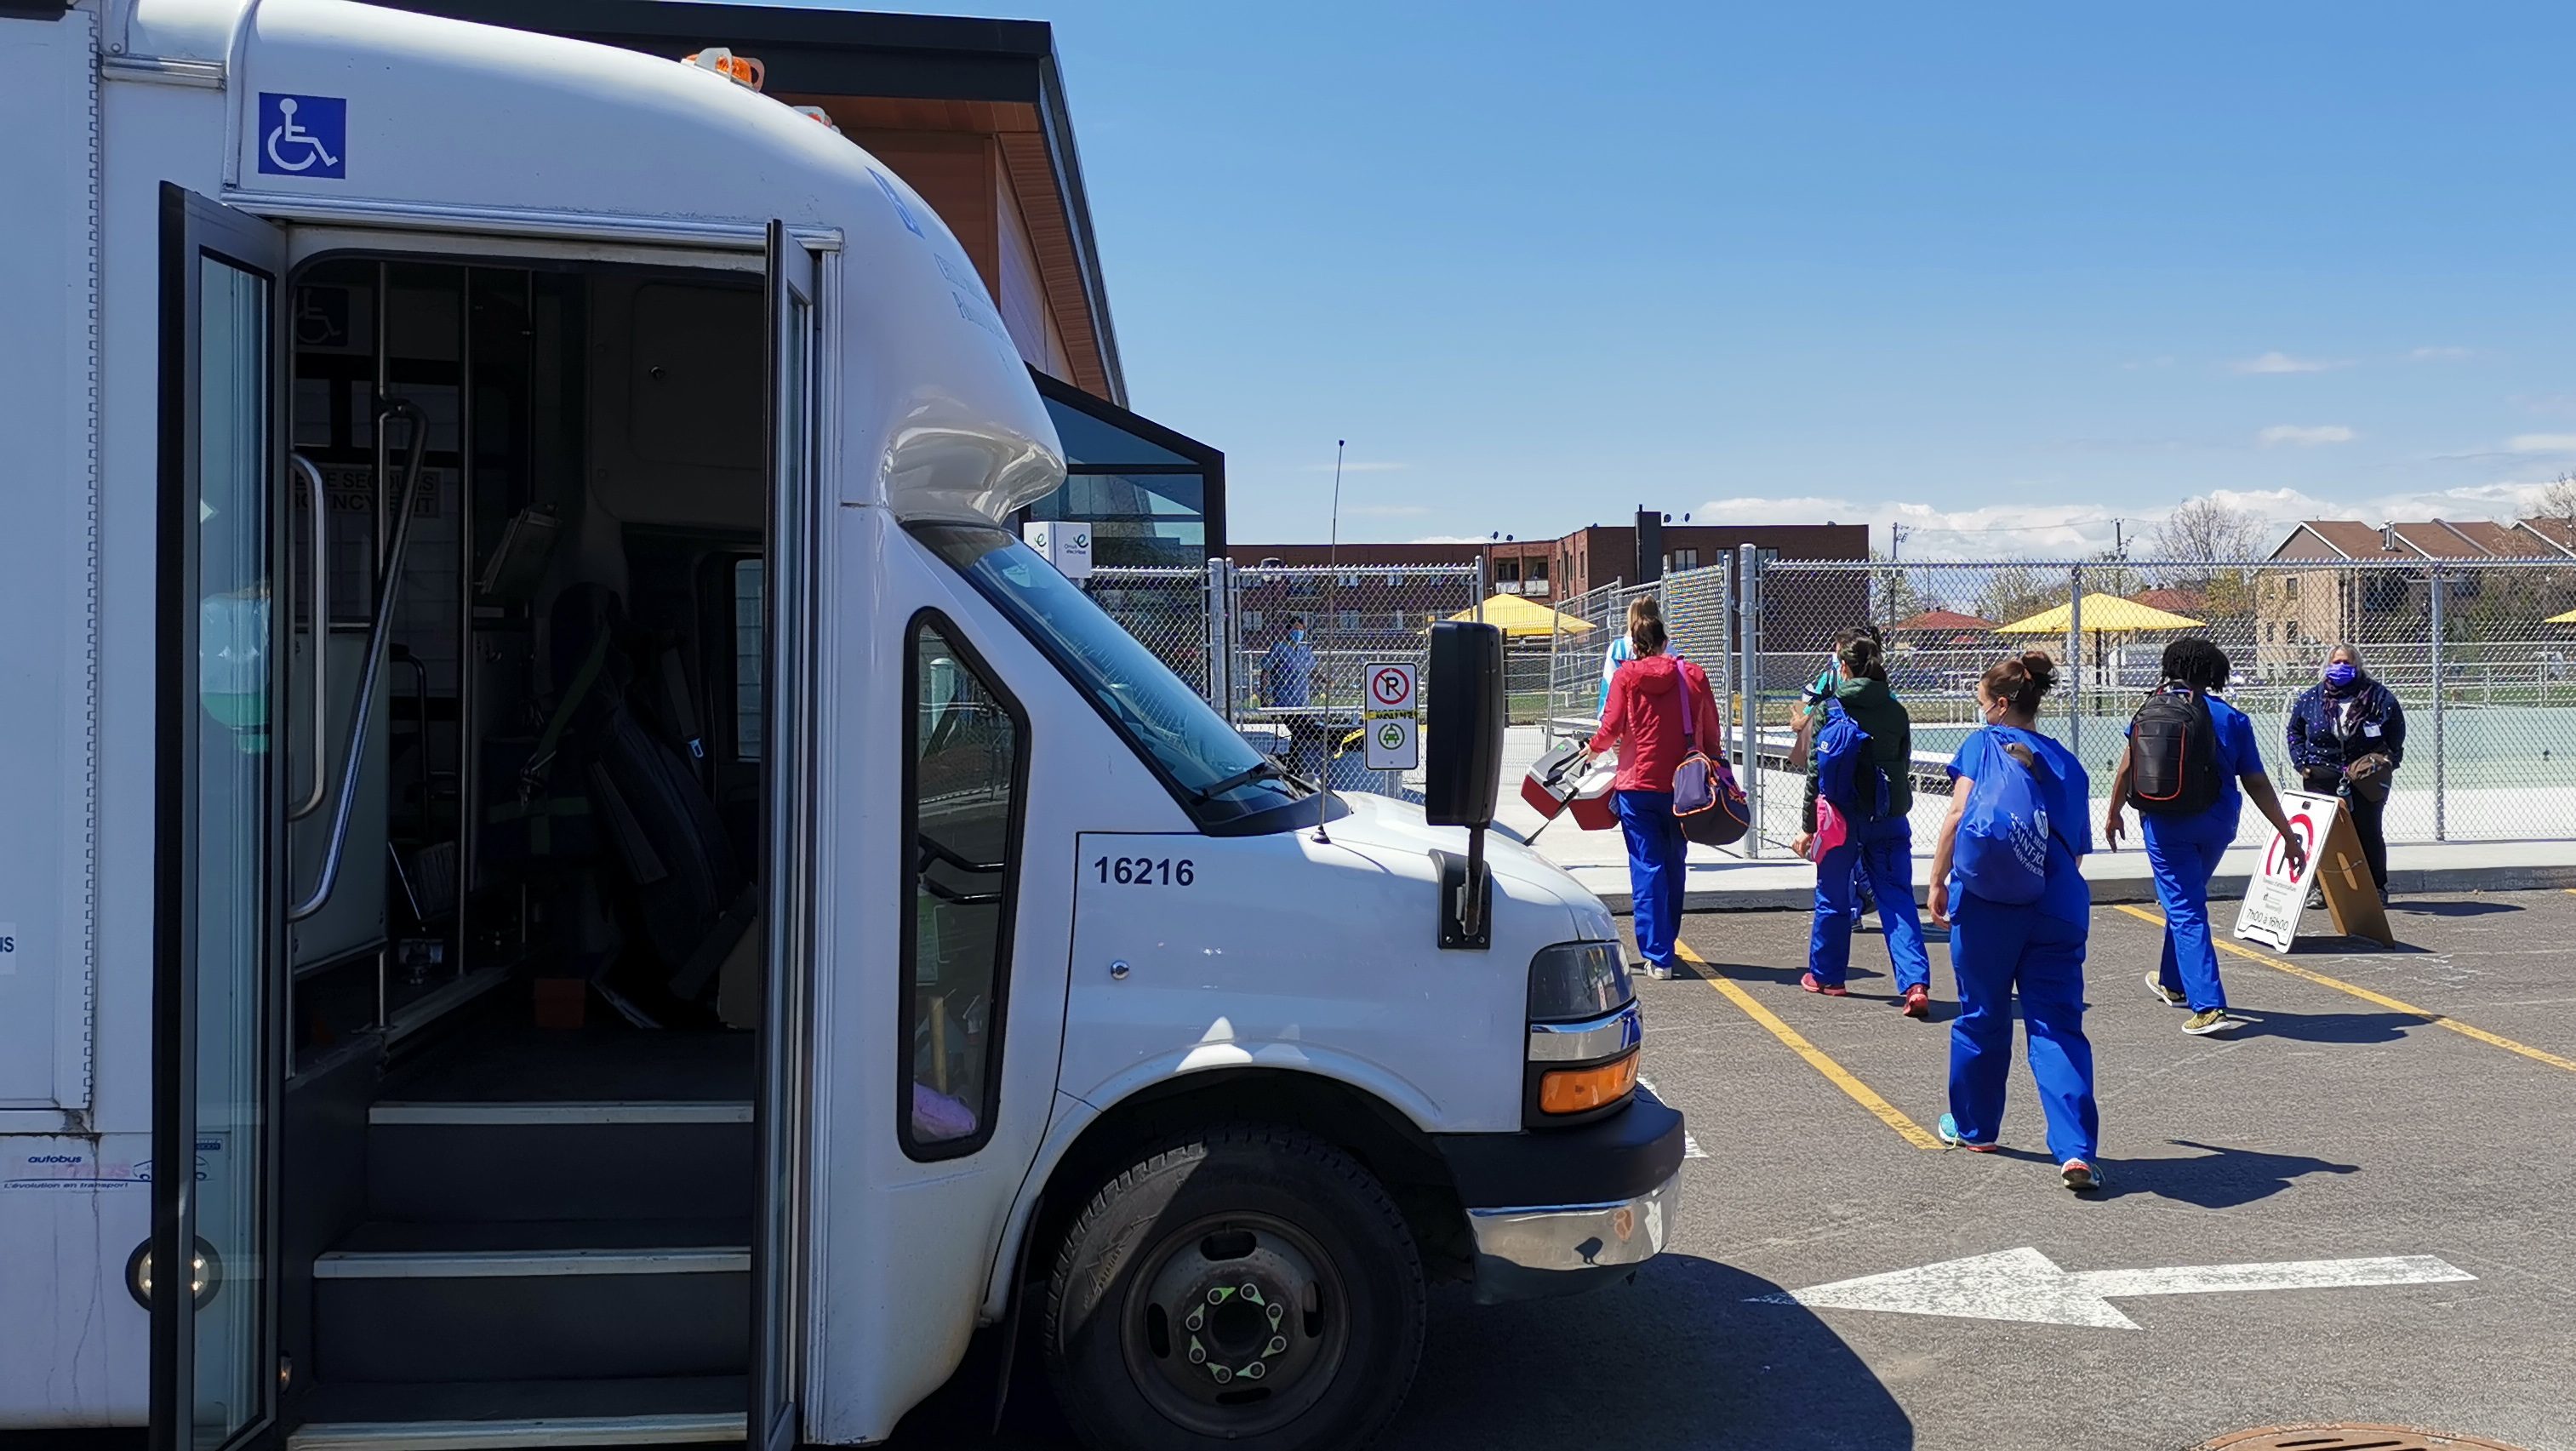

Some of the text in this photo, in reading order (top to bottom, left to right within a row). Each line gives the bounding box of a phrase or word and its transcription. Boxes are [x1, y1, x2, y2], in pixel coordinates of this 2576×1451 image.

[1385, 677, 1399, 696] P
[1094, 856, 1194, 887] 16216
[28, 1155, 82, 1163] autobus
[80, 1181, 129, 1190] transport
